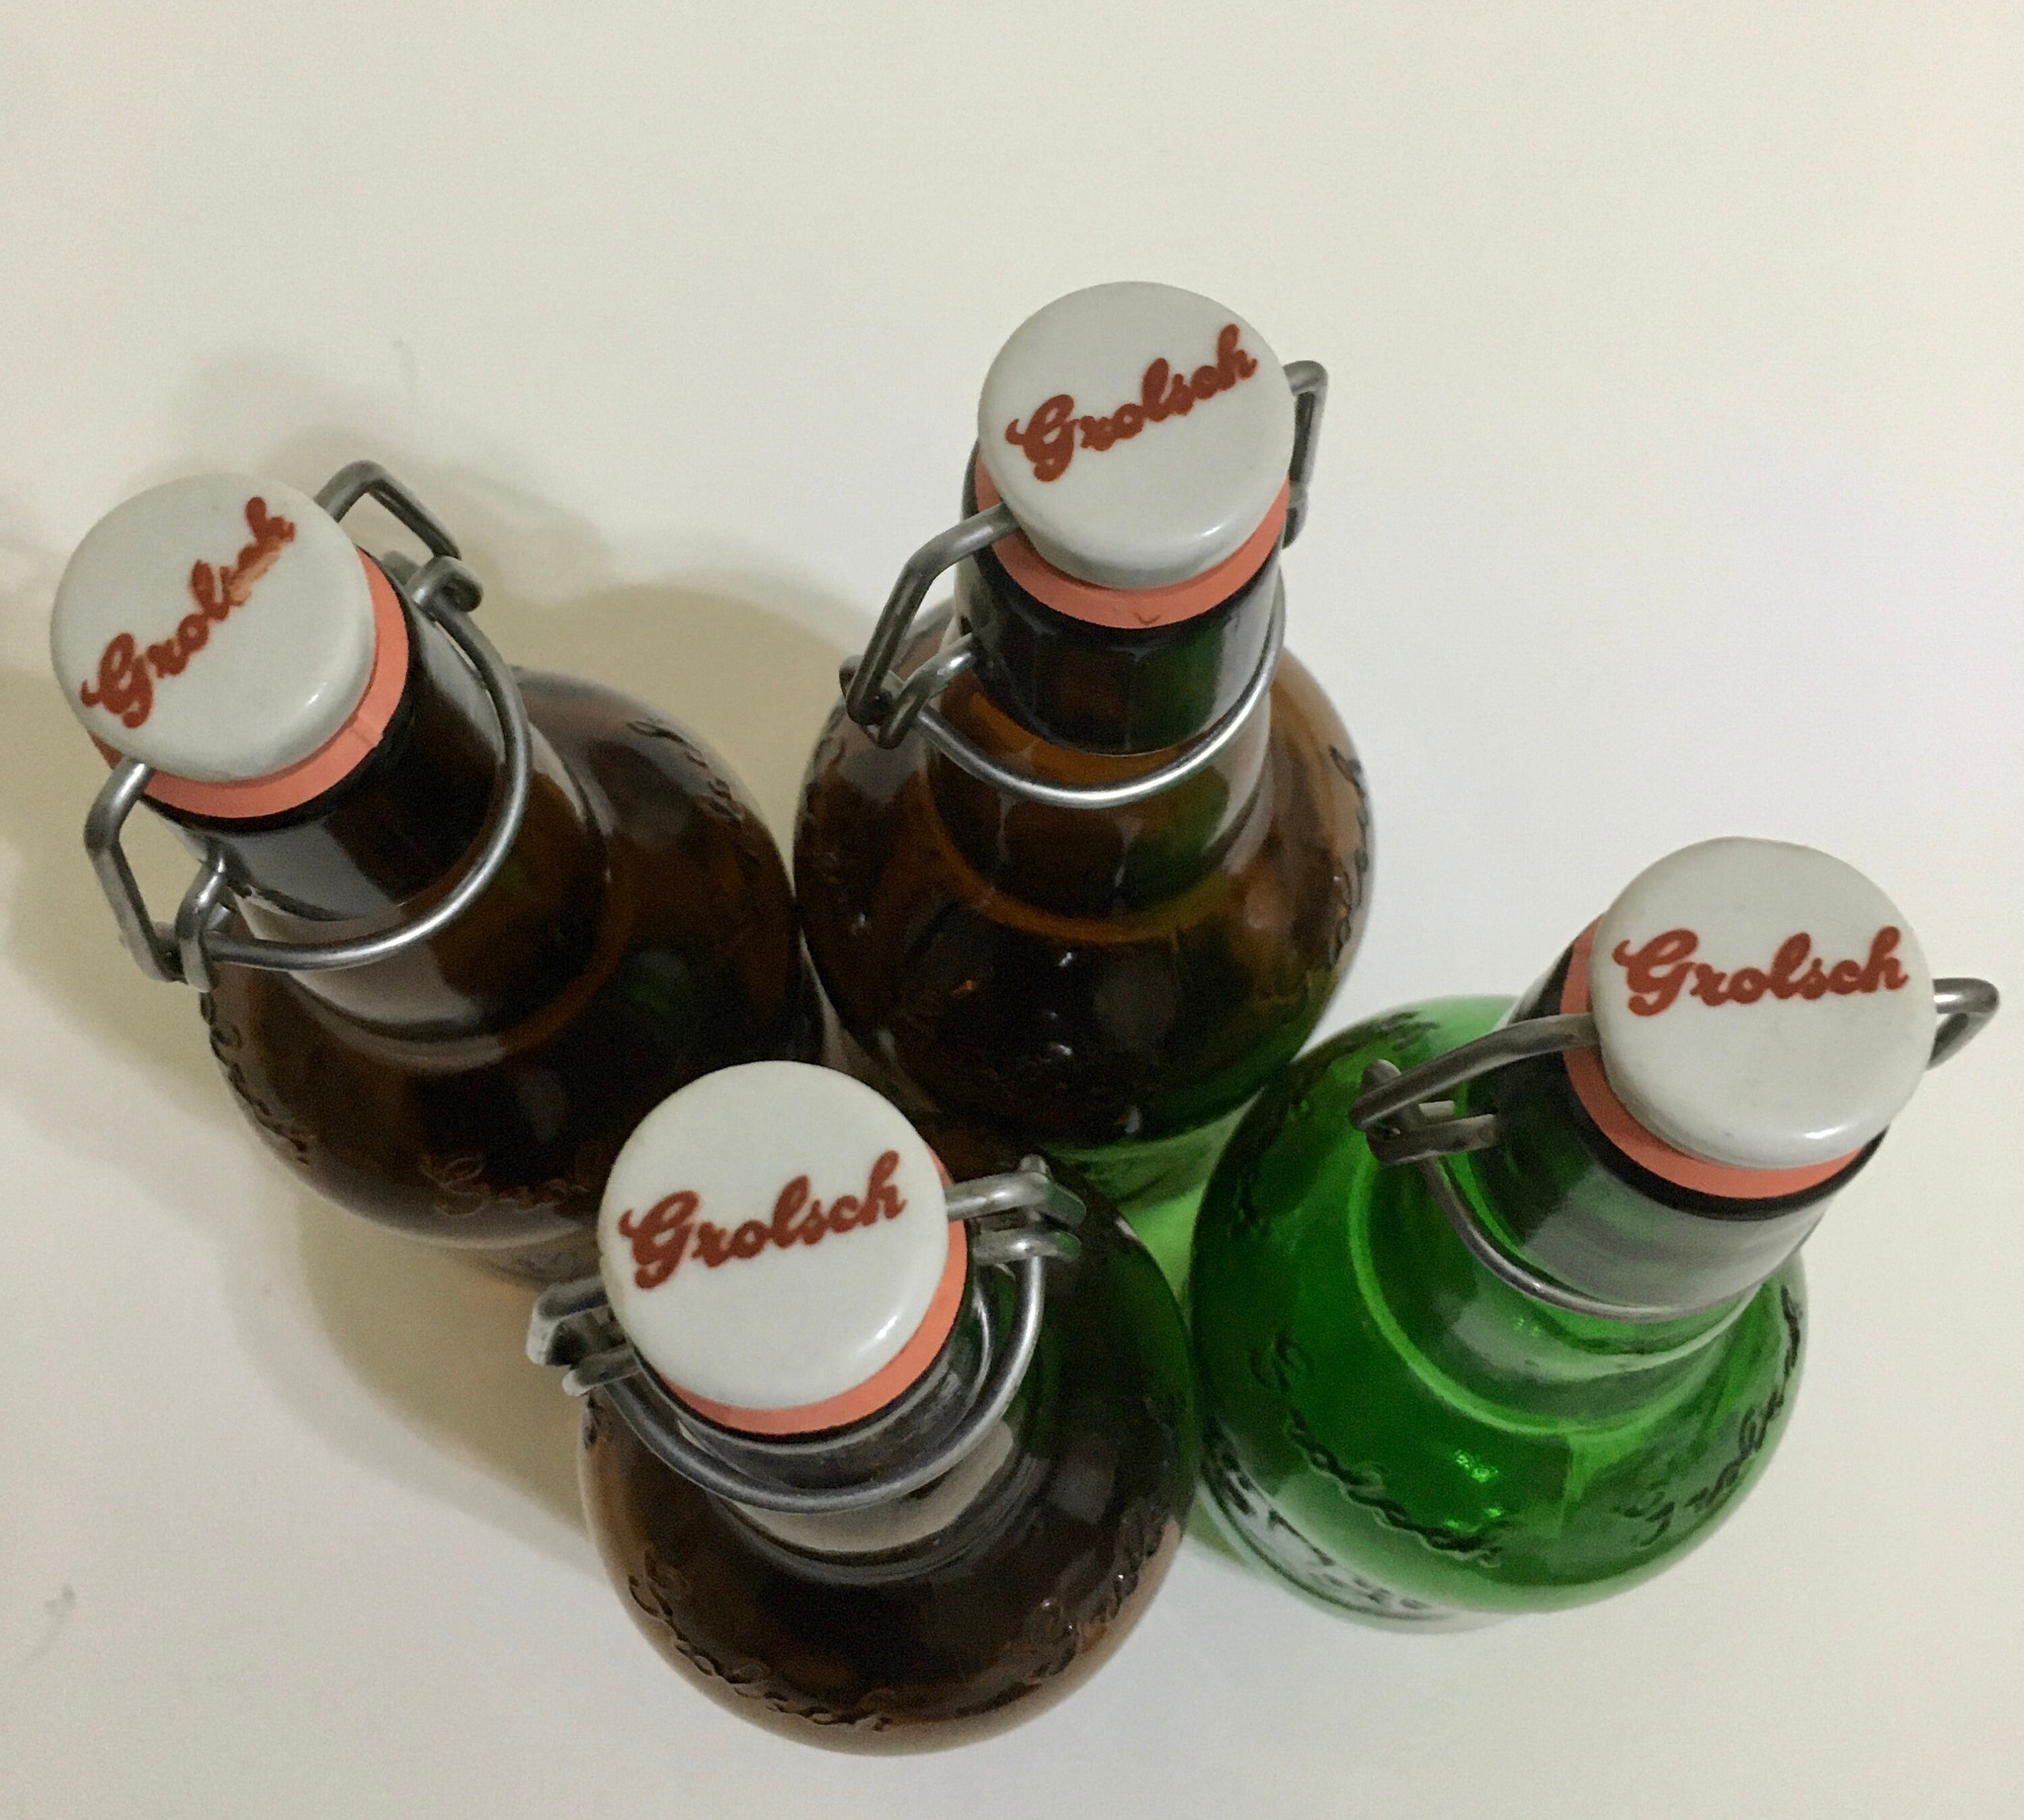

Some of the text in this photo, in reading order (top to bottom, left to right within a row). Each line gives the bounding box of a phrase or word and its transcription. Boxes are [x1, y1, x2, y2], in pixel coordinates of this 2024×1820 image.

[1005, 323, 1258, 482] Grolsch
[1613, 926, 1909, 1017] Grolsch
[619, 1150, 907, 1288] Grolsch
